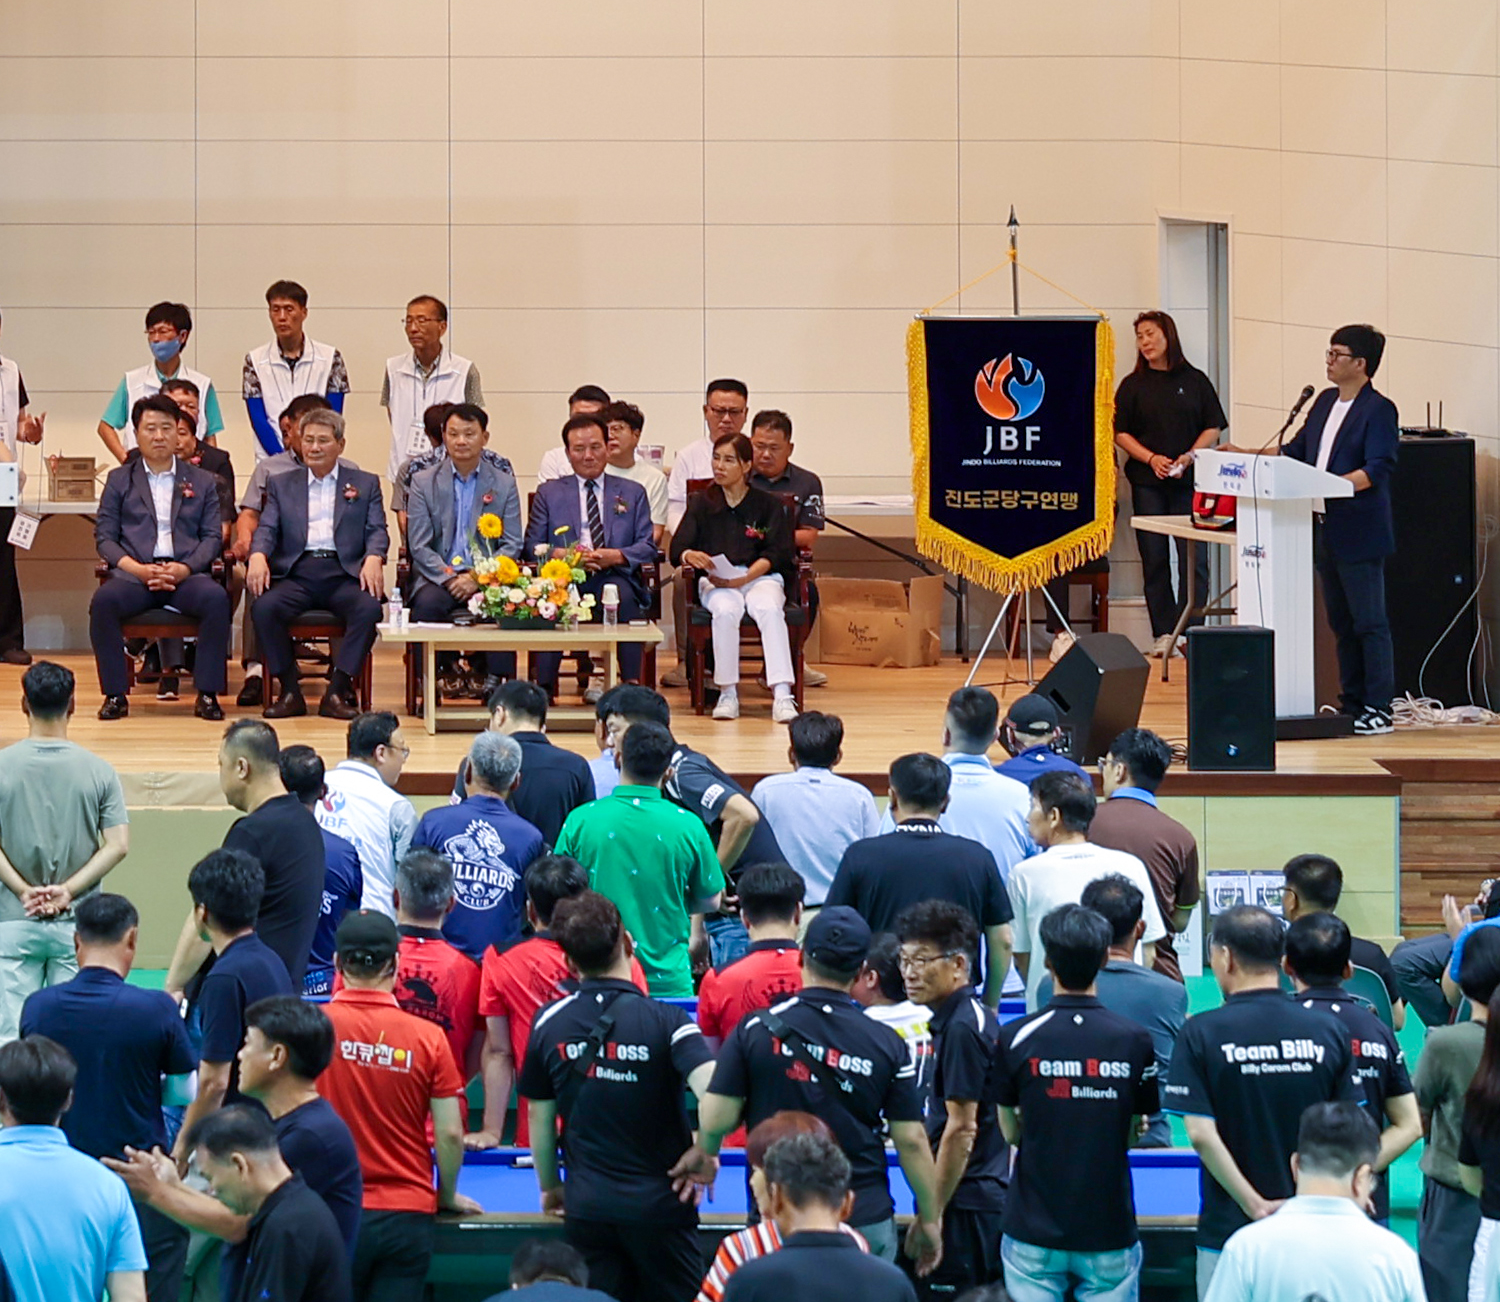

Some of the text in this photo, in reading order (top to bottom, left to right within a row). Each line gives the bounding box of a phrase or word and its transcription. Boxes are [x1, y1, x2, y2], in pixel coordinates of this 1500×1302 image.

[983, 425, 1042, 457] JBF
[961, 459, 982, 467] JINDO
[944, 488, 1079, 512] 진도군당구연맹
[453, 863, 515, 892] ILLIARDS
[1220, 1038, 1326, 1064] Team Billy
[595, 1065, 639, 1083] Billiards
[1028, 1057, 1131, 1079] Team Boss
[1240, 1063, 1261, 1076] Billy
[1291, 1061, 1314, 1073] Club
[1071, 1084, 1119, 1100] Billiards
